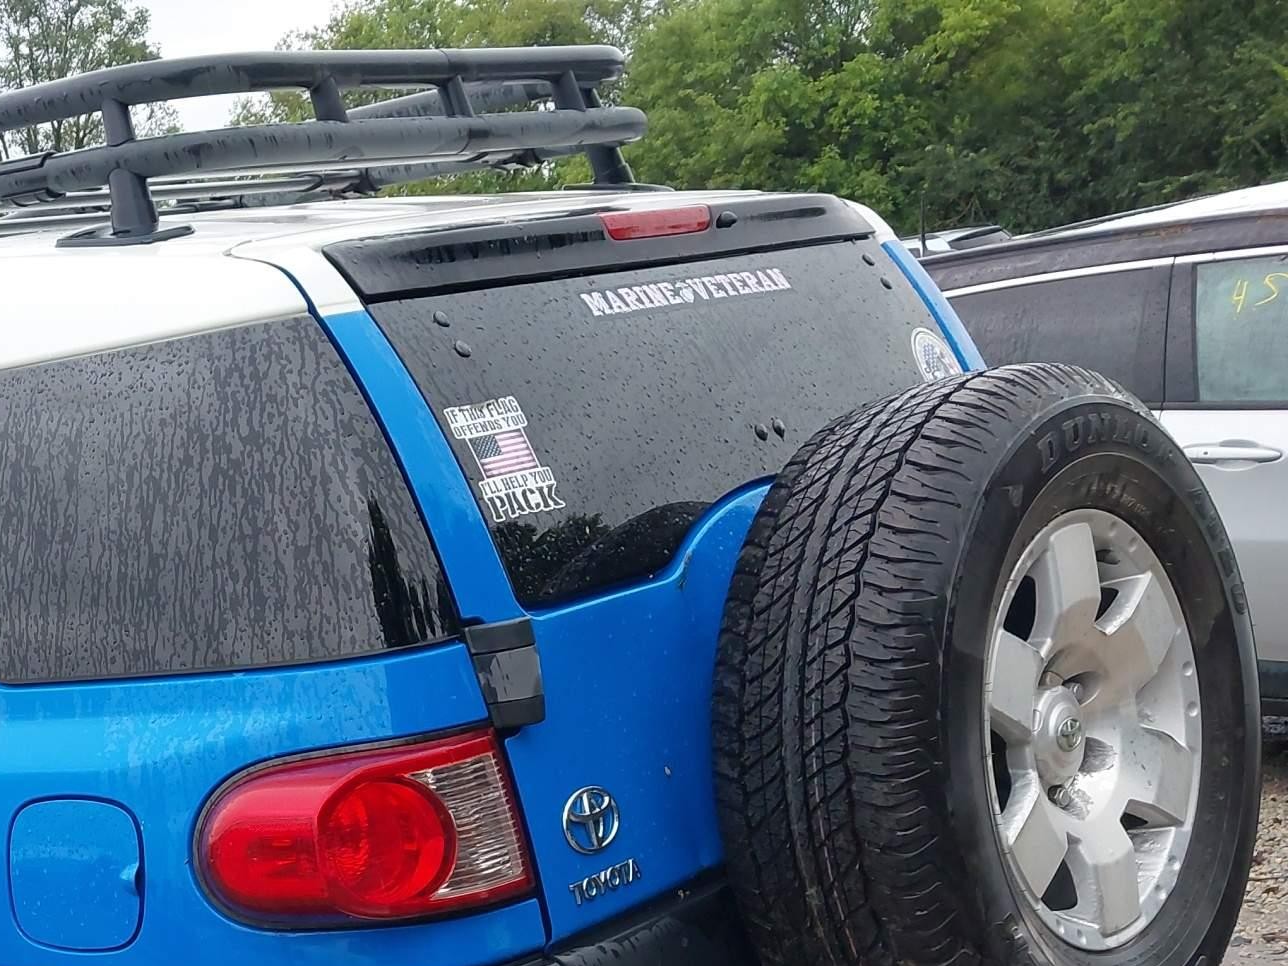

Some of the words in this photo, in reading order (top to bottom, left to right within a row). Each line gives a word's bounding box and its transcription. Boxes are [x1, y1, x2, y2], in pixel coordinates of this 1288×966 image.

[580, 281, 682, 316] MARINE
[685, 268, 792, 300] VETERAN
[445, 408, 459, 424] IF
[459, 406, 486, 424] THIS
[486, 398, 520, 418] FLAG
[453, 419, 503, 437] OFFENDS
[502, 413, 526, 428] YOU
[480, 480, 503, 496] I'LL
[503, 473, 529, 491] HELP
[530, 469, 553, 485] YOU
[487, 483, 564, 520] PACK
[569, 858, 641, 905] TOYOTA
